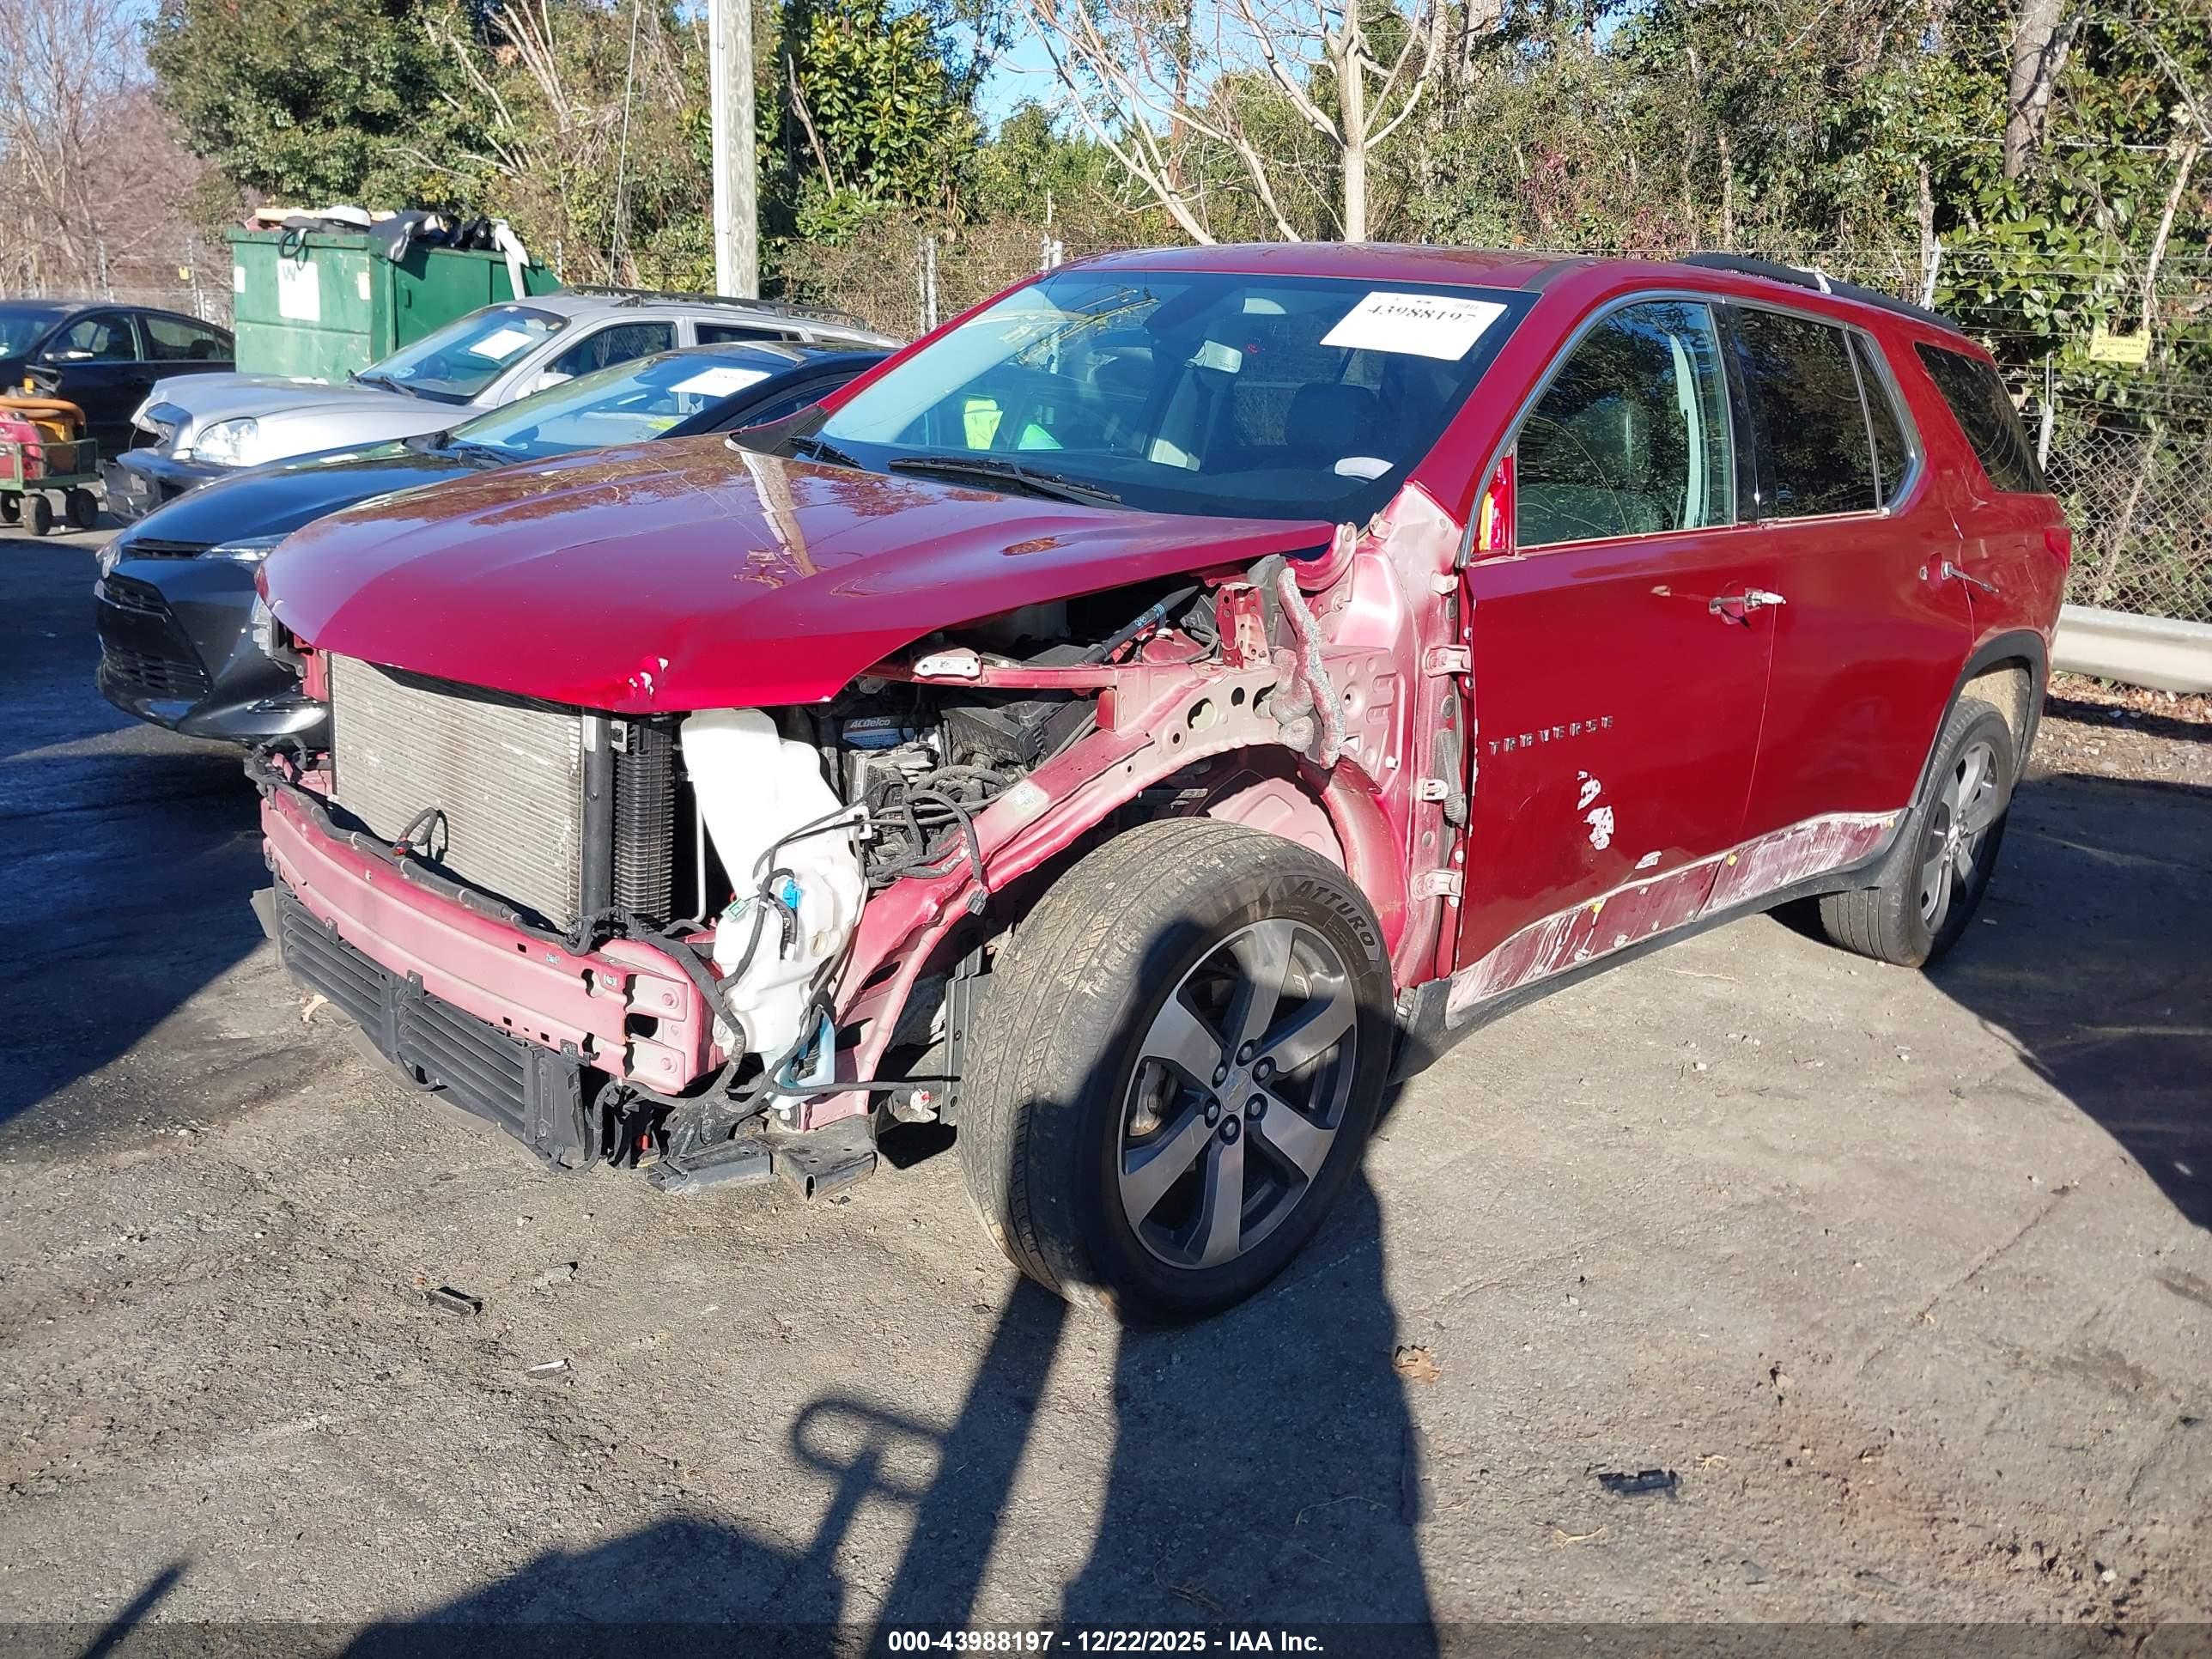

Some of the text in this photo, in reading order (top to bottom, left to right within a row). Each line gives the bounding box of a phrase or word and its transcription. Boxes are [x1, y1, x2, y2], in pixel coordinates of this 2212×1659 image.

[1367, 304, 1477, 324] 43988197
[850, 717, 891, 729] ACDelco
[1488, 715, 1613, 756] TRAVERSE
[1288, 880, 1376, 947] ATTURO
